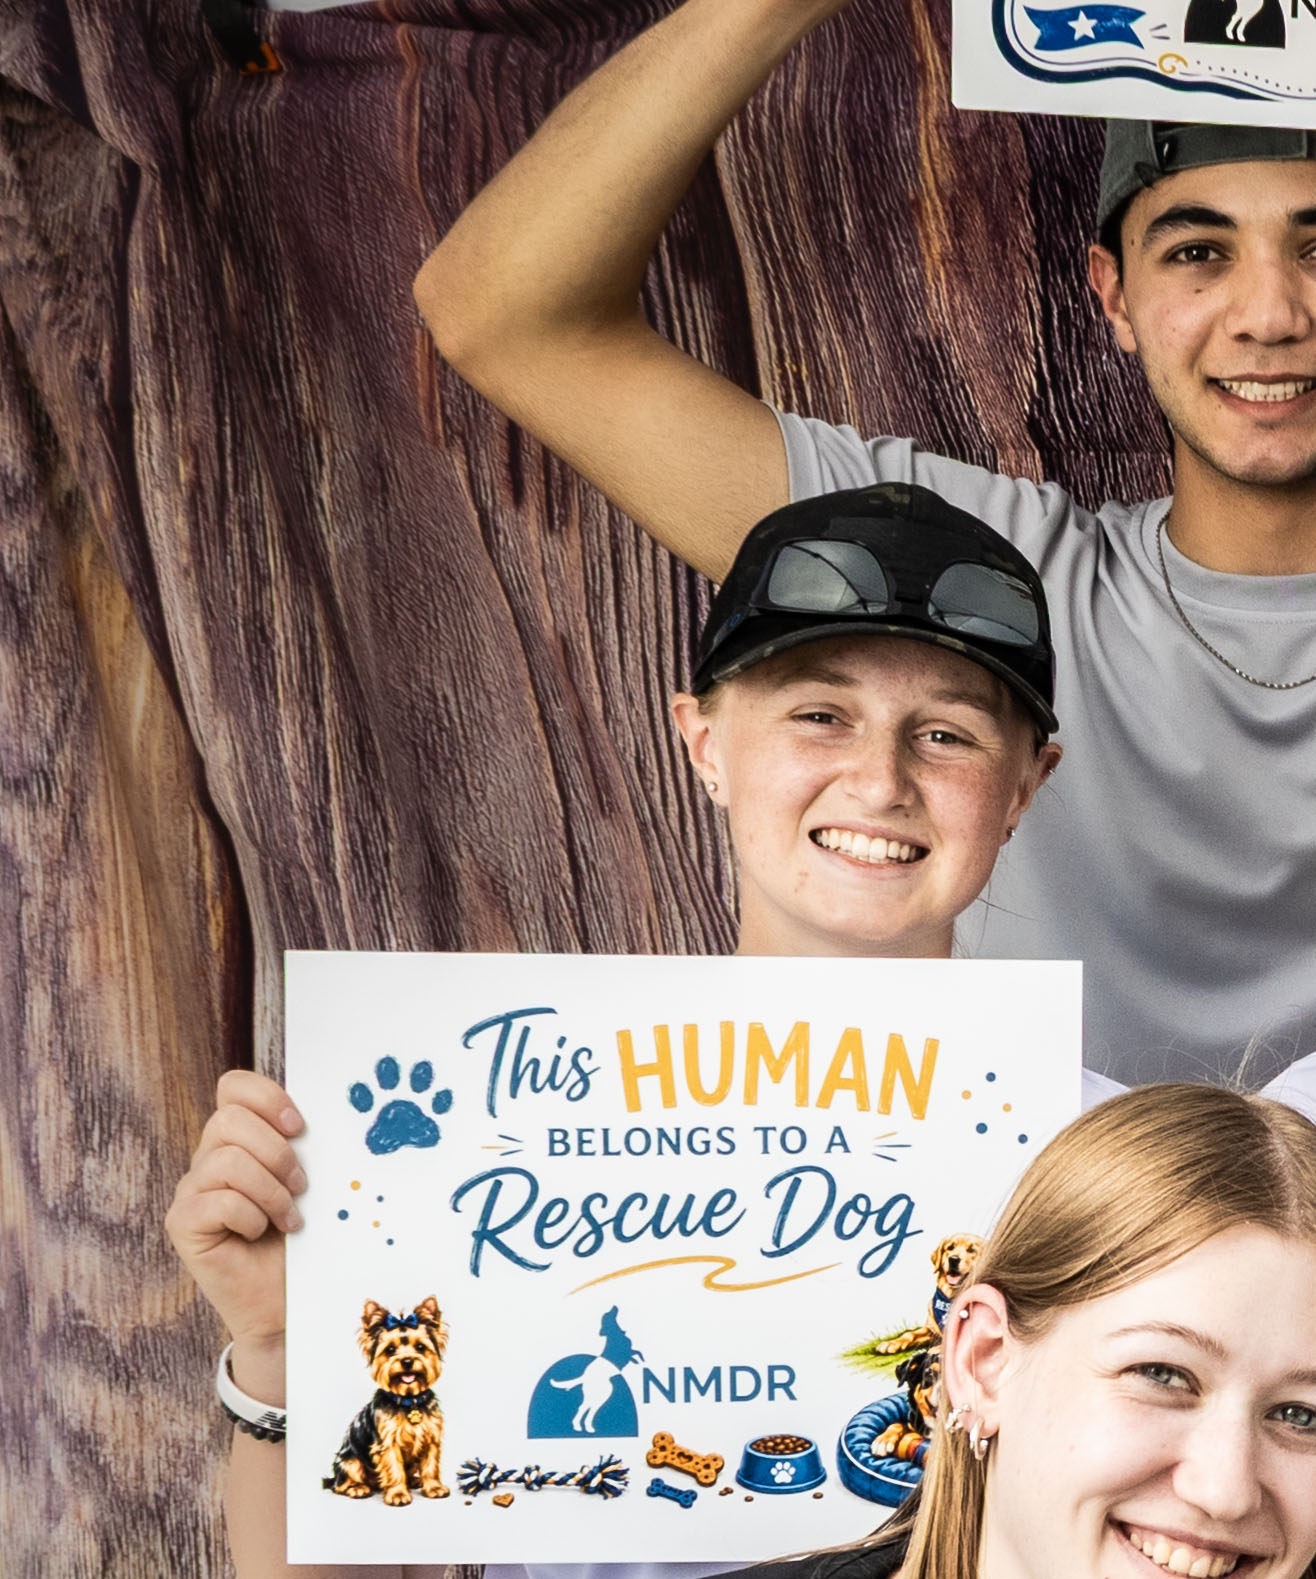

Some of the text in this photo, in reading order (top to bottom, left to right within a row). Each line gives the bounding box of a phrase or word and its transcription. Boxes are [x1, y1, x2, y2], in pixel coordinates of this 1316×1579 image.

[463, 1008, 939, 1121] This HUMAN
[547, 1125, 851, 1157] BELONGS TO A
[453, 1165, 923, 1279] Rescue Dog
[642, 1364, 798, 1404] NMDR
